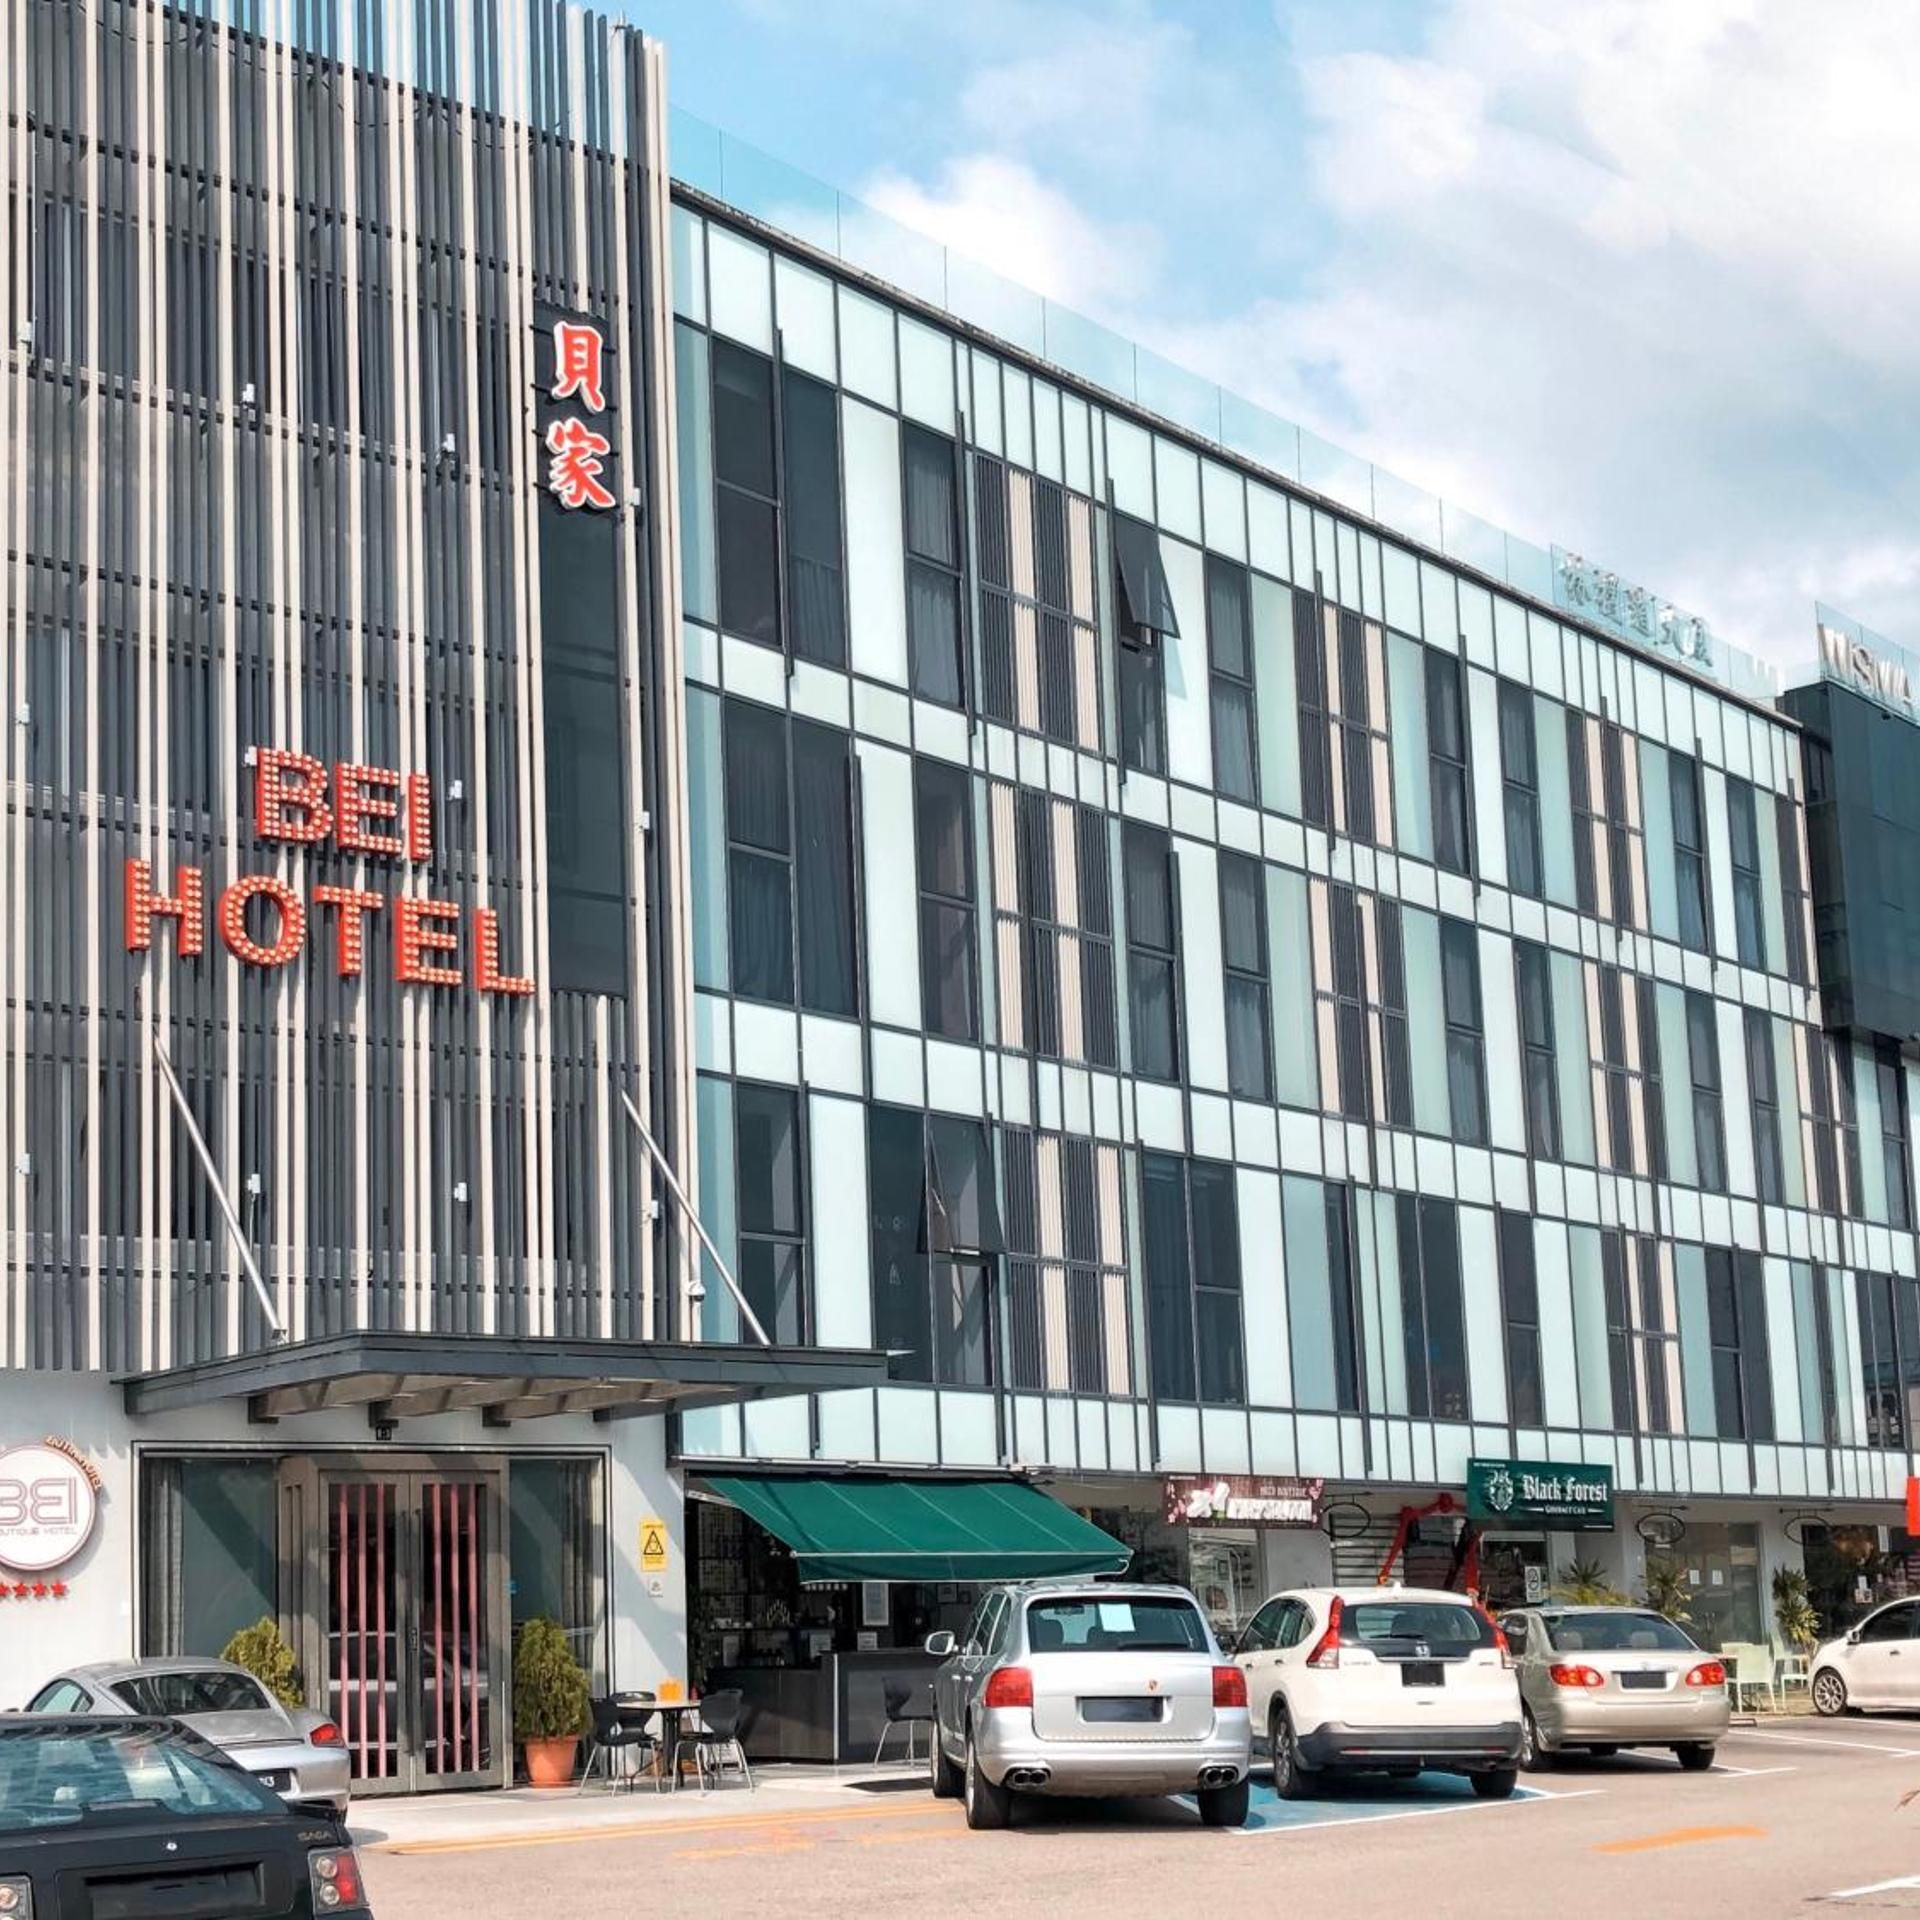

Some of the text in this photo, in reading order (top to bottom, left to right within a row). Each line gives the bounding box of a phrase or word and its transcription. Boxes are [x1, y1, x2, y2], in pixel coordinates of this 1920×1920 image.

[546, 320, 617, 510] 貝家
[256, 745, 433, 861] BEI
[124, 857, 537, 998] HOTEL
[0, 1527, 39, 1536] OUTIQUE
[1521, 1473, 1608, 1502] Black Forest
